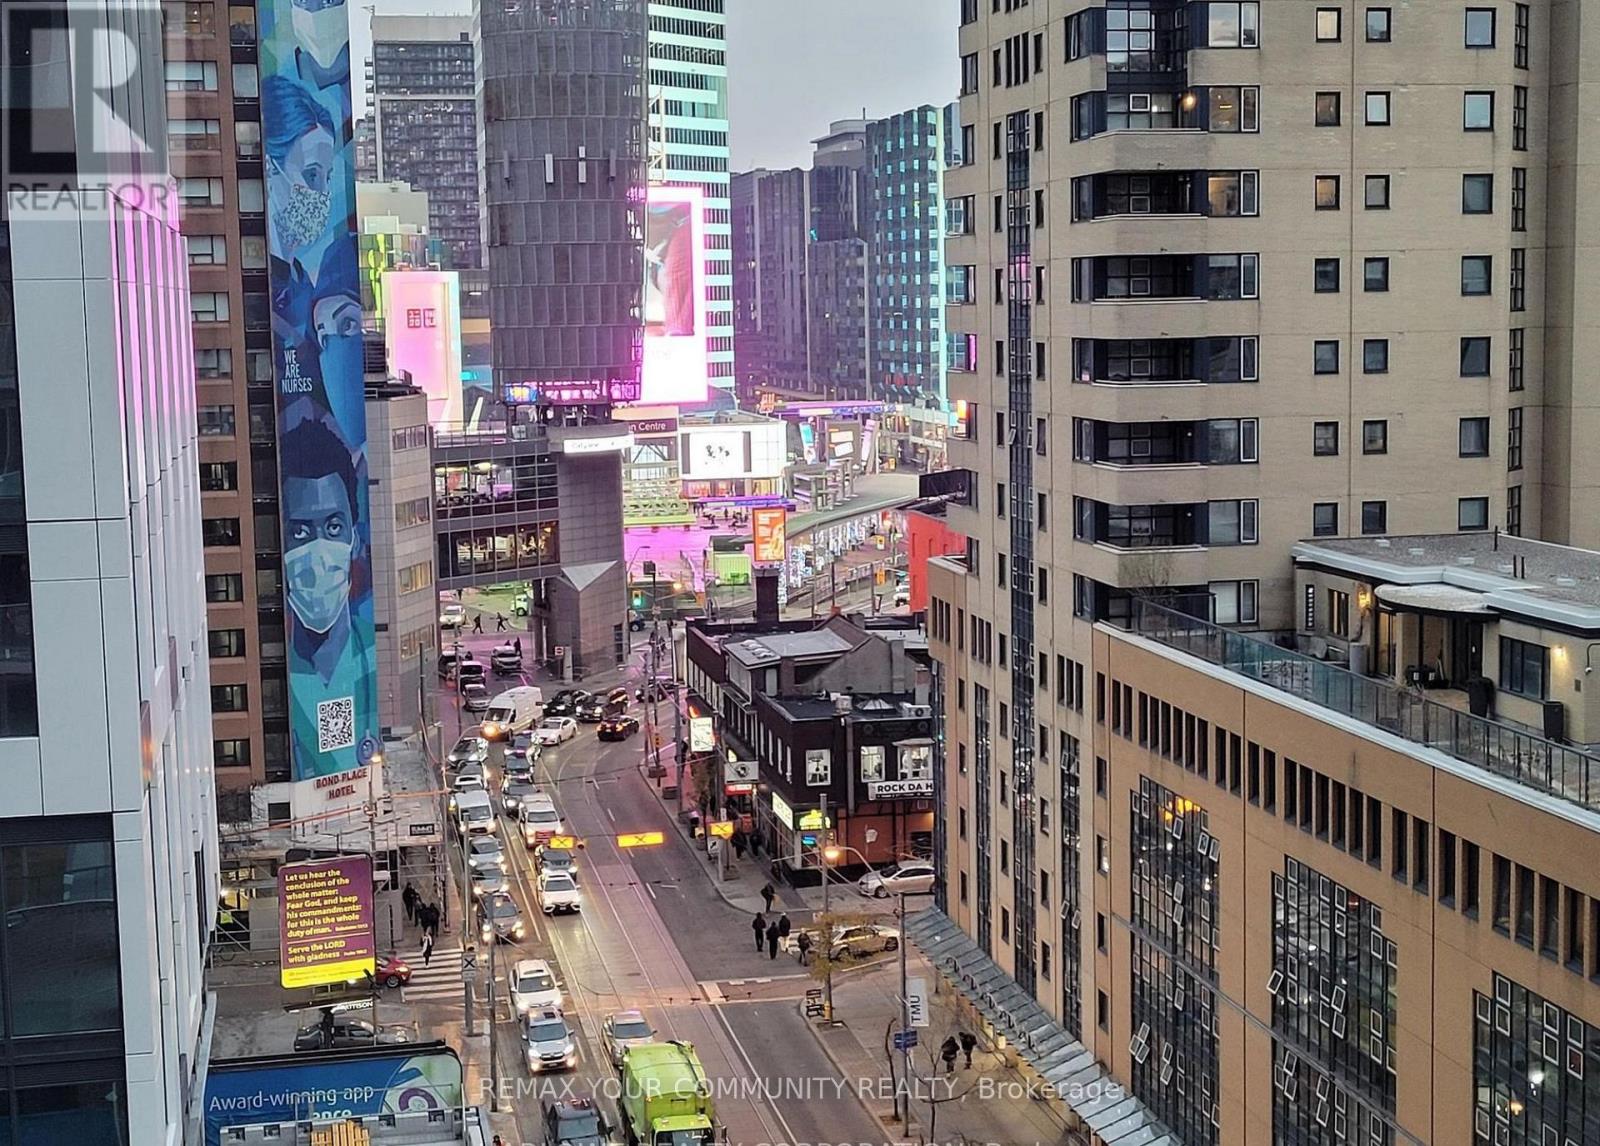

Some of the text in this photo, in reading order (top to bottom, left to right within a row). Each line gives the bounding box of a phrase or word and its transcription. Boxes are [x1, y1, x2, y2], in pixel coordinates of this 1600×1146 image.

[284, 350, 297, 364] WE
[285, 363, 300, 378] ARE
[282, 377, 313, 393] NURSES
[638, 422, 667, 431] Centre
[315, 767, 368, 789] BOND PLACE
[328, 785, 356, 800] HOTEL
[877, 784, 906, 792] ROCK
[908, 783, 923, 791] DA
[285, 874, 298, 882] Let
[309, 871, 327, 879] hear
[327, 869, 341, 877] the
[286, 877, 350, 891] conclusion of the
[286, 889, 339, 900] whole matter:
[286, 895, 358, 910] Fear God, and keep
[286, 911, 298, 919] his
[287, 920, 299, 929] for
[300, 918, 314, 927] this
[322, 916, 336, 924] the
[336, 913, 360, 922] whole
[287, 929, 305, 938] duty
[305, 927, 314, 936] of
[313, 926, 332, 935] man.
[288, 940, 346, 955] Serve the LORD
[288, 954, 306, 964] with
[306, 951, 340, 963] gladness
[910, 995, 921, 1023] TMU
[208, 1086, 374, 1112] Award-winning app
